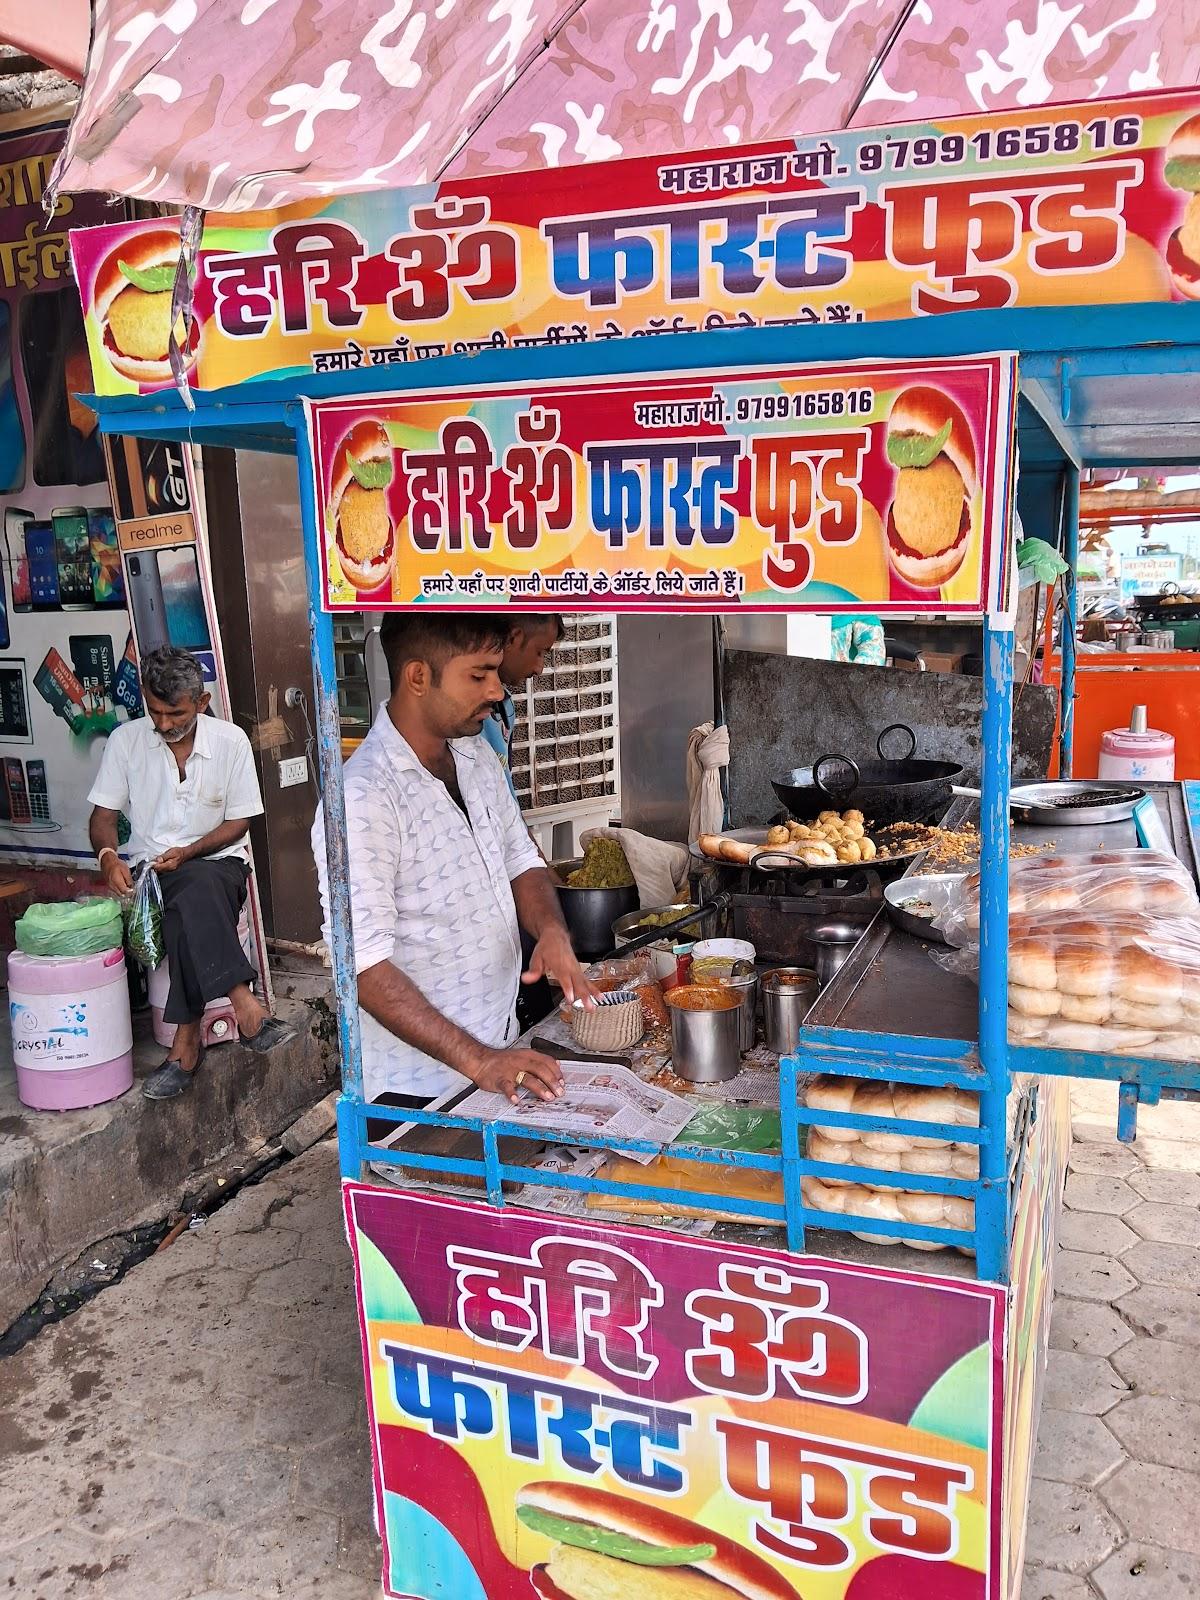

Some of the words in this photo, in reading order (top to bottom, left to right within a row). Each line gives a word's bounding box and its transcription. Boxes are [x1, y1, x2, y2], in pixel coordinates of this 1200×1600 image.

[660, 155, 785, 192] महाराज
[859, 116, 1140, 171] 9799165816
[207, 222, 365, 336] हरि
[544, 191, 860, 307] फास्ट
[636, 400, 701, 425] महाराज
[736, 390, 873, 420] 9799165816
[164, 447, 188, 507] GT
[404, 420, 494, 551] हरि
[587, 439, 741, 548] फास्ट
[751, 431, 869, 590] फुड
[129, 523, 183, 542] realme
[422, 573, 454, 594] हमारे
[458, 571, 482, 594] यहाँ
[486, 578, 505, 592] पर
[509, 572, 541, 593] शादी
[593, 571, 609, 592] के
[613, 571, 652, 592] ऑर्डर
[655, 571, 685, 592] लिये
[689, 570, 720, 592] जाते
[100, 645, 112, 688] SanDisk
[116, 679, 137, 708] 8GB
[449, 1237, 664, 1380] हरि
[380, 1340, 694, 1496] फास्ट
[715, 1417, 975, 1571] फुड
